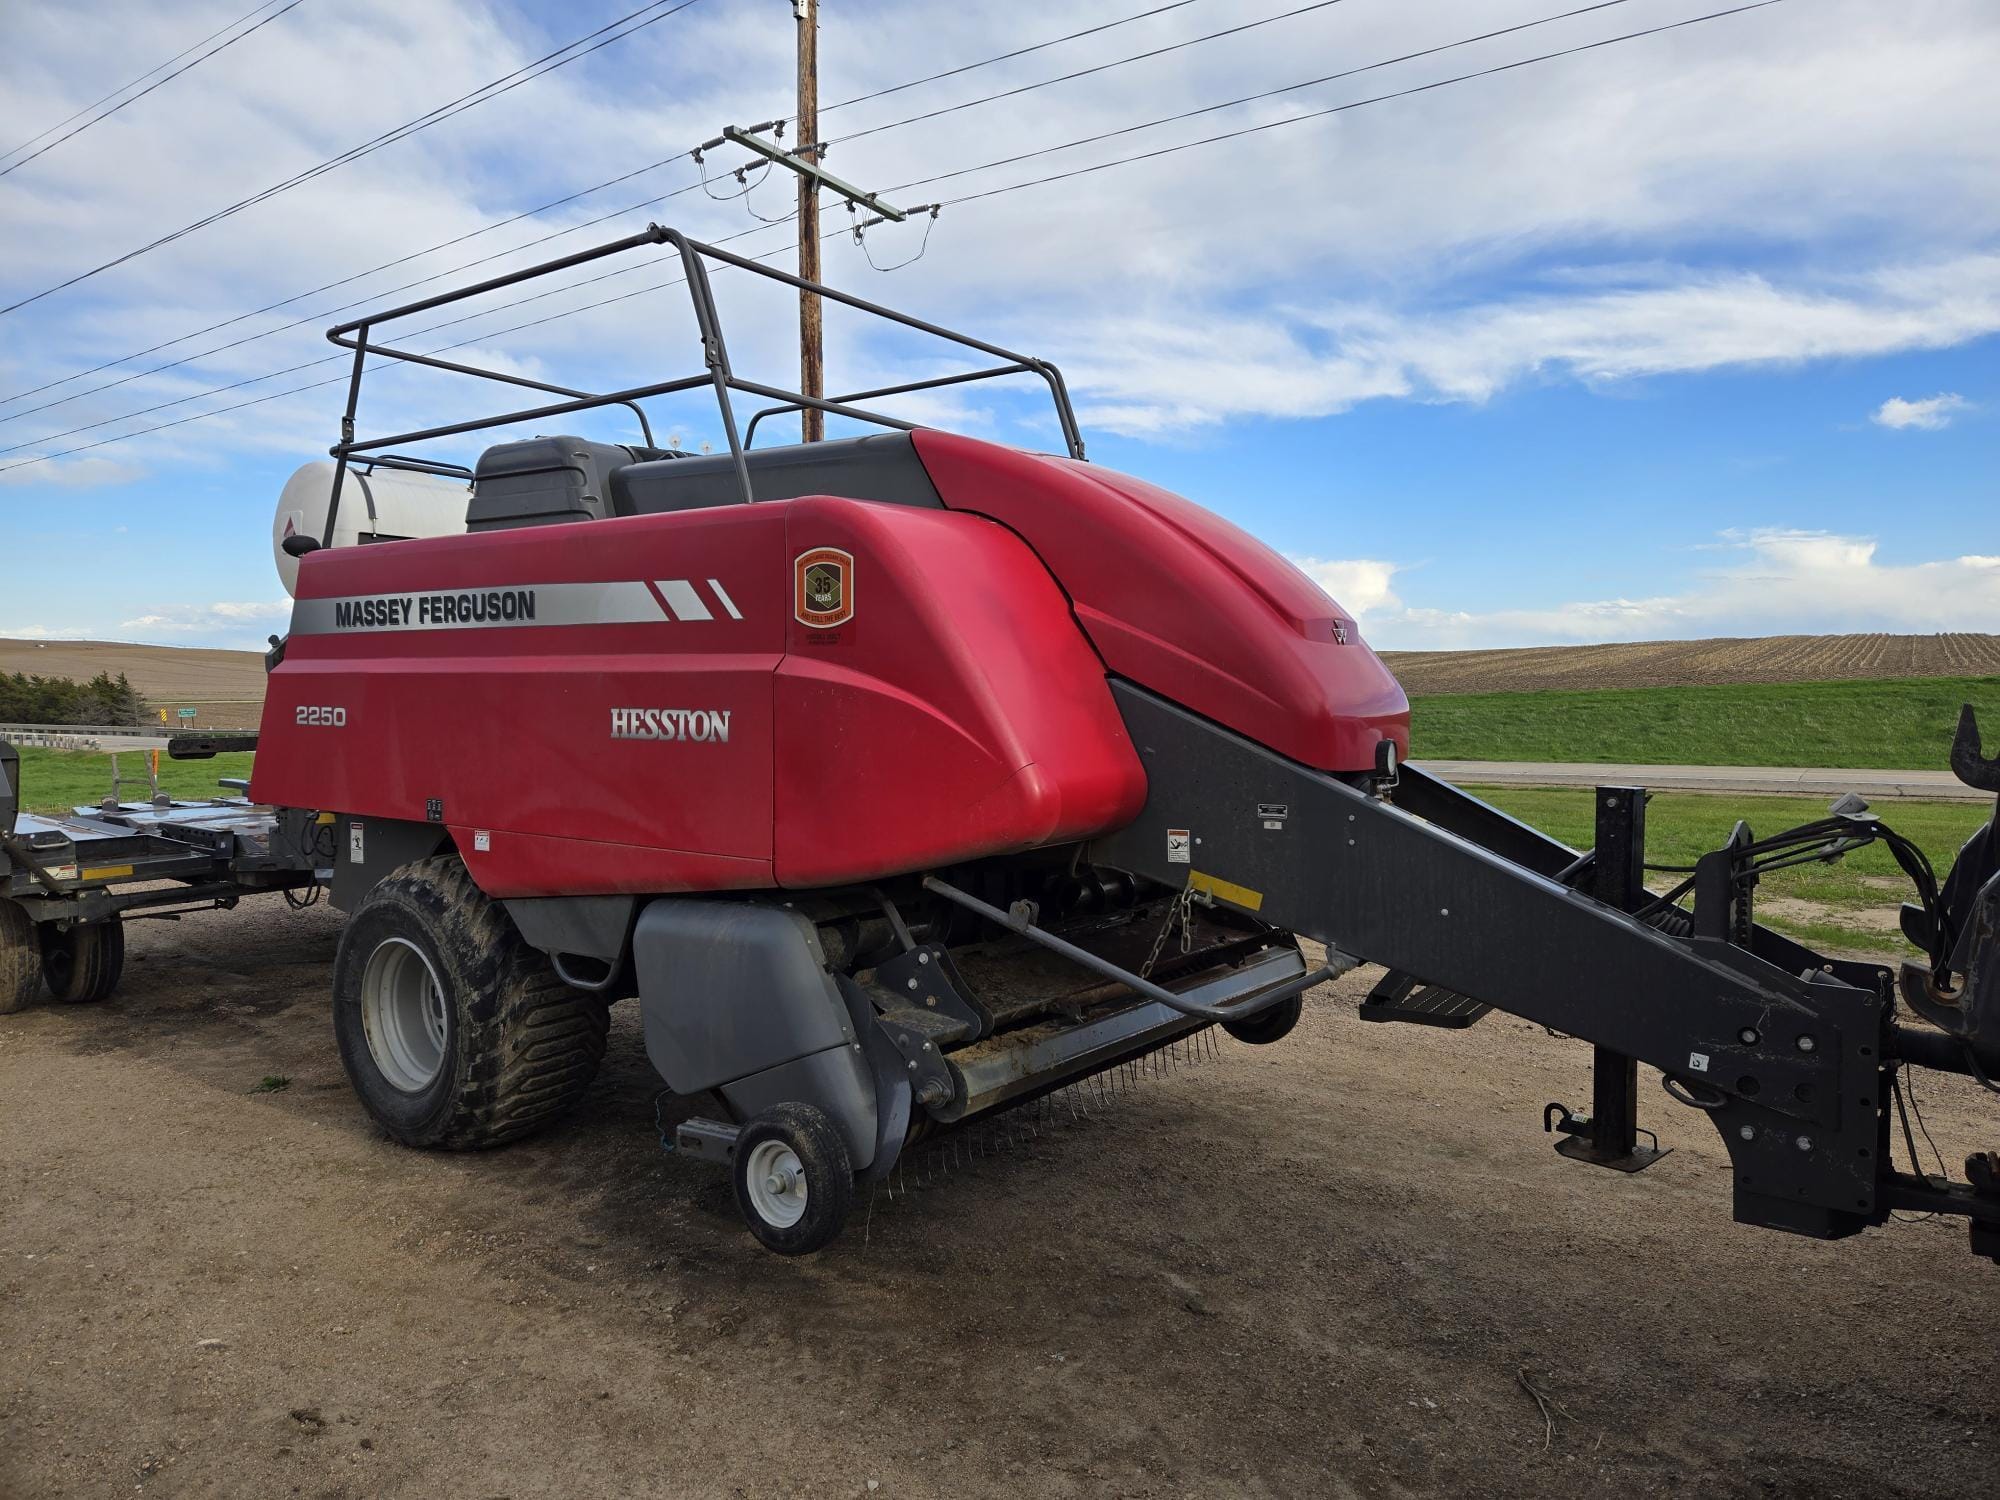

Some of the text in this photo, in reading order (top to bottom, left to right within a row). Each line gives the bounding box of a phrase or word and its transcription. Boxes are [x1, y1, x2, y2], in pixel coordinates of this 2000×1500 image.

[815, 576, 831, 594] 35
[815, 593, 832, 602] YEARS
[335, 590, 536, 628] MASSEY FERGUSON
[801, 611, 810, 620] AND
[835, 610, 846, 620] BEST
[296, 706, 347, 728] 2250
[610, 708, 731, 743] HESSTON
